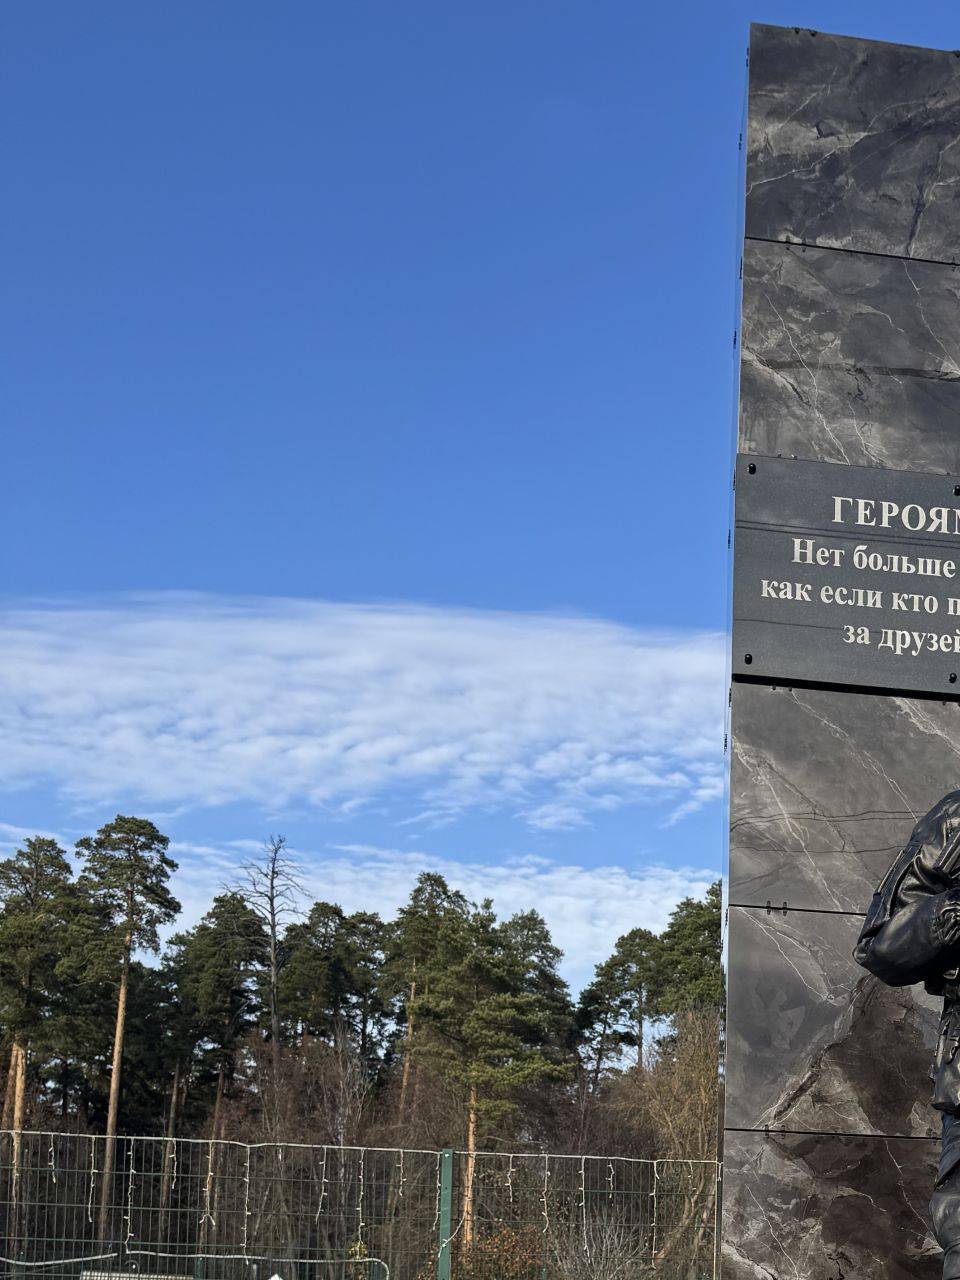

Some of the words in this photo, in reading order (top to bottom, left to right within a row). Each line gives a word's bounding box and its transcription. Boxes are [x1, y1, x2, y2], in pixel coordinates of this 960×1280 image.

[791, 537, 845, 567] Нет
[853, 544, 957, 579] больше
[760, 579, 812, 602] как
[820, 585, 884, 609] если
[891, 592, 939, 614] кто
[842, 624, 871, 646] за
